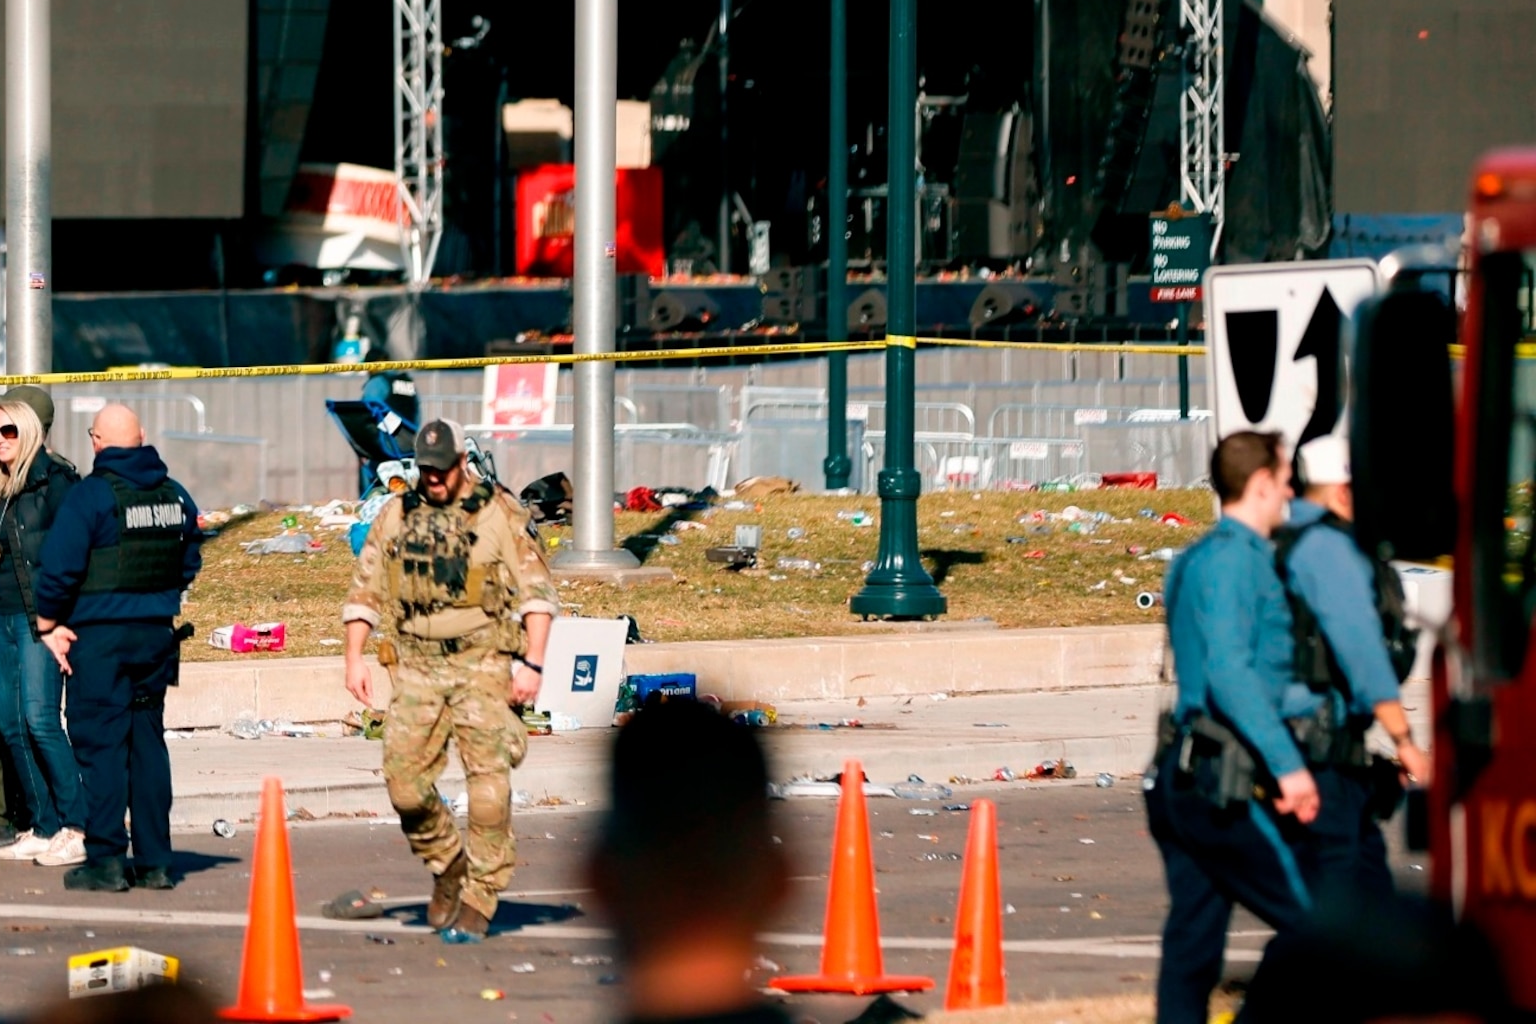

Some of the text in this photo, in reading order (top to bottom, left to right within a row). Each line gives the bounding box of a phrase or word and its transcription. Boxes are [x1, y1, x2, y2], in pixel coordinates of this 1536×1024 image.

[1153, 220, 1168, 235] NO
[1153, 253, 1169, 268] NO
[125, 503, 183, 529] BOMB SQUAD
